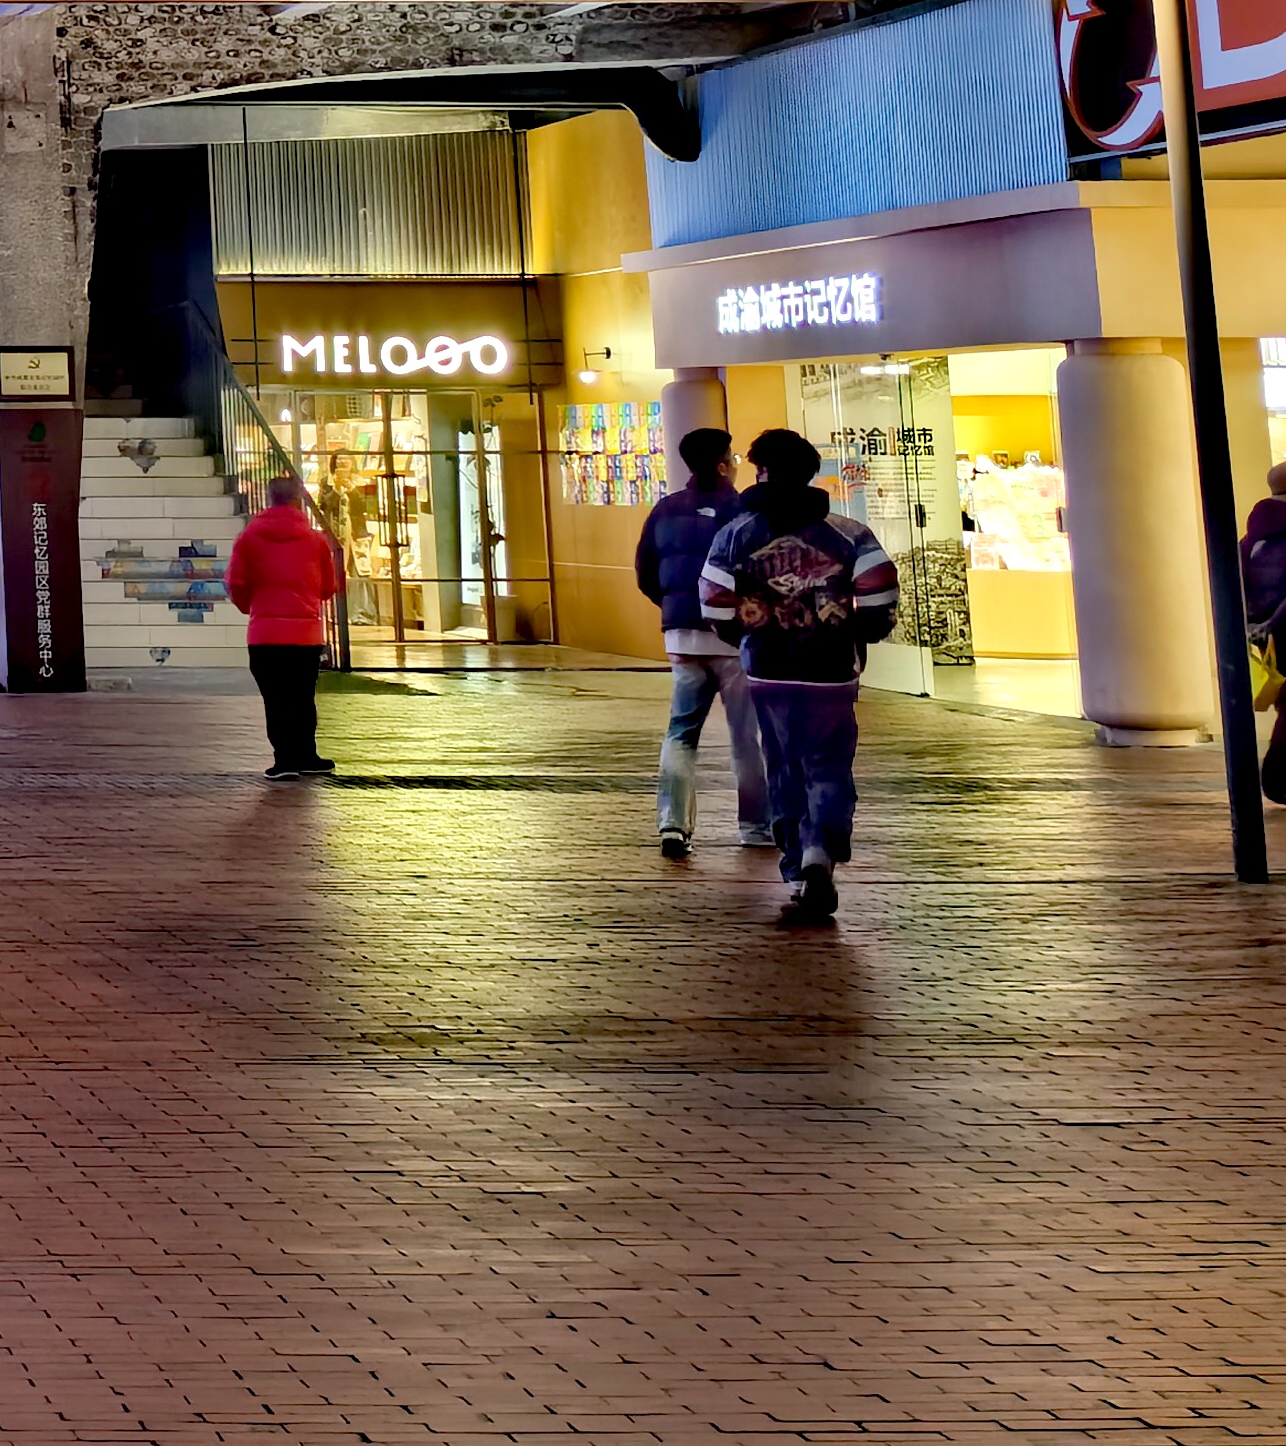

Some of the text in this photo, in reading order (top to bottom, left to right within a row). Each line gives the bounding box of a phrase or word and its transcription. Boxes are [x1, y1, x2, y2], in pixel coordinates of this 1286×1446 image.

[717, 273, 881, 334] 成渝城市记忆馆
[32, 502, 55, 678] 东郊记忆园区党群服务中心
